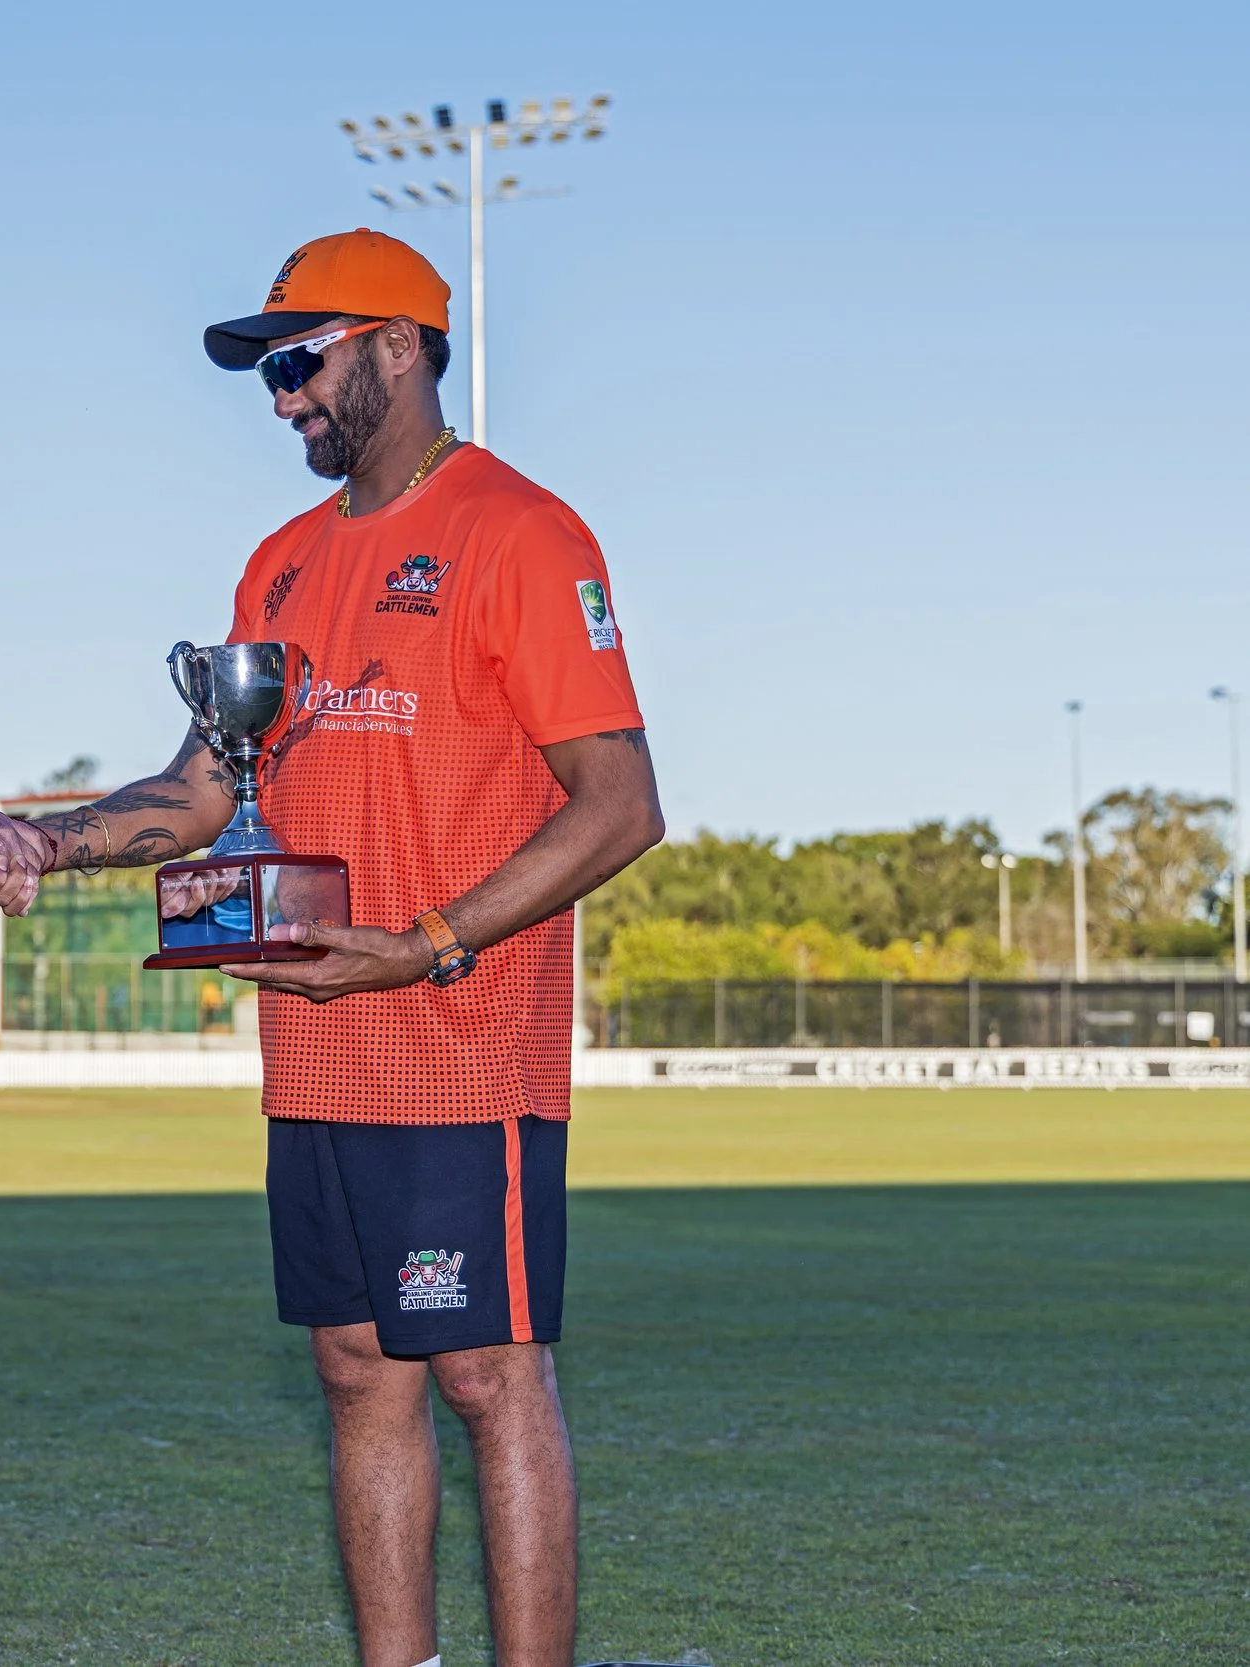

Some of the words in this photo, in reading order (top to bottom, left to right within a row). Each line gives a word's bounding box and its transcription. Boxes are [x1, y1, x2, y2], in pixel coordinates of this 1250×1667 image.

[411, 595, 433, 604] DOWNS
[375, 600, 440, 617] CATTLEMEN
[312, 716, 366, 732] Financia
[817, 1056, 939, 1083] CRICKET
[953, 1056, 1010, 1082] BAT
[1025, 1055, 1148, 1082] REPAIRS
[406, 1289, 432, 1298] DARLING
[400, 1295, 466, 1310] CATTLEMEN
